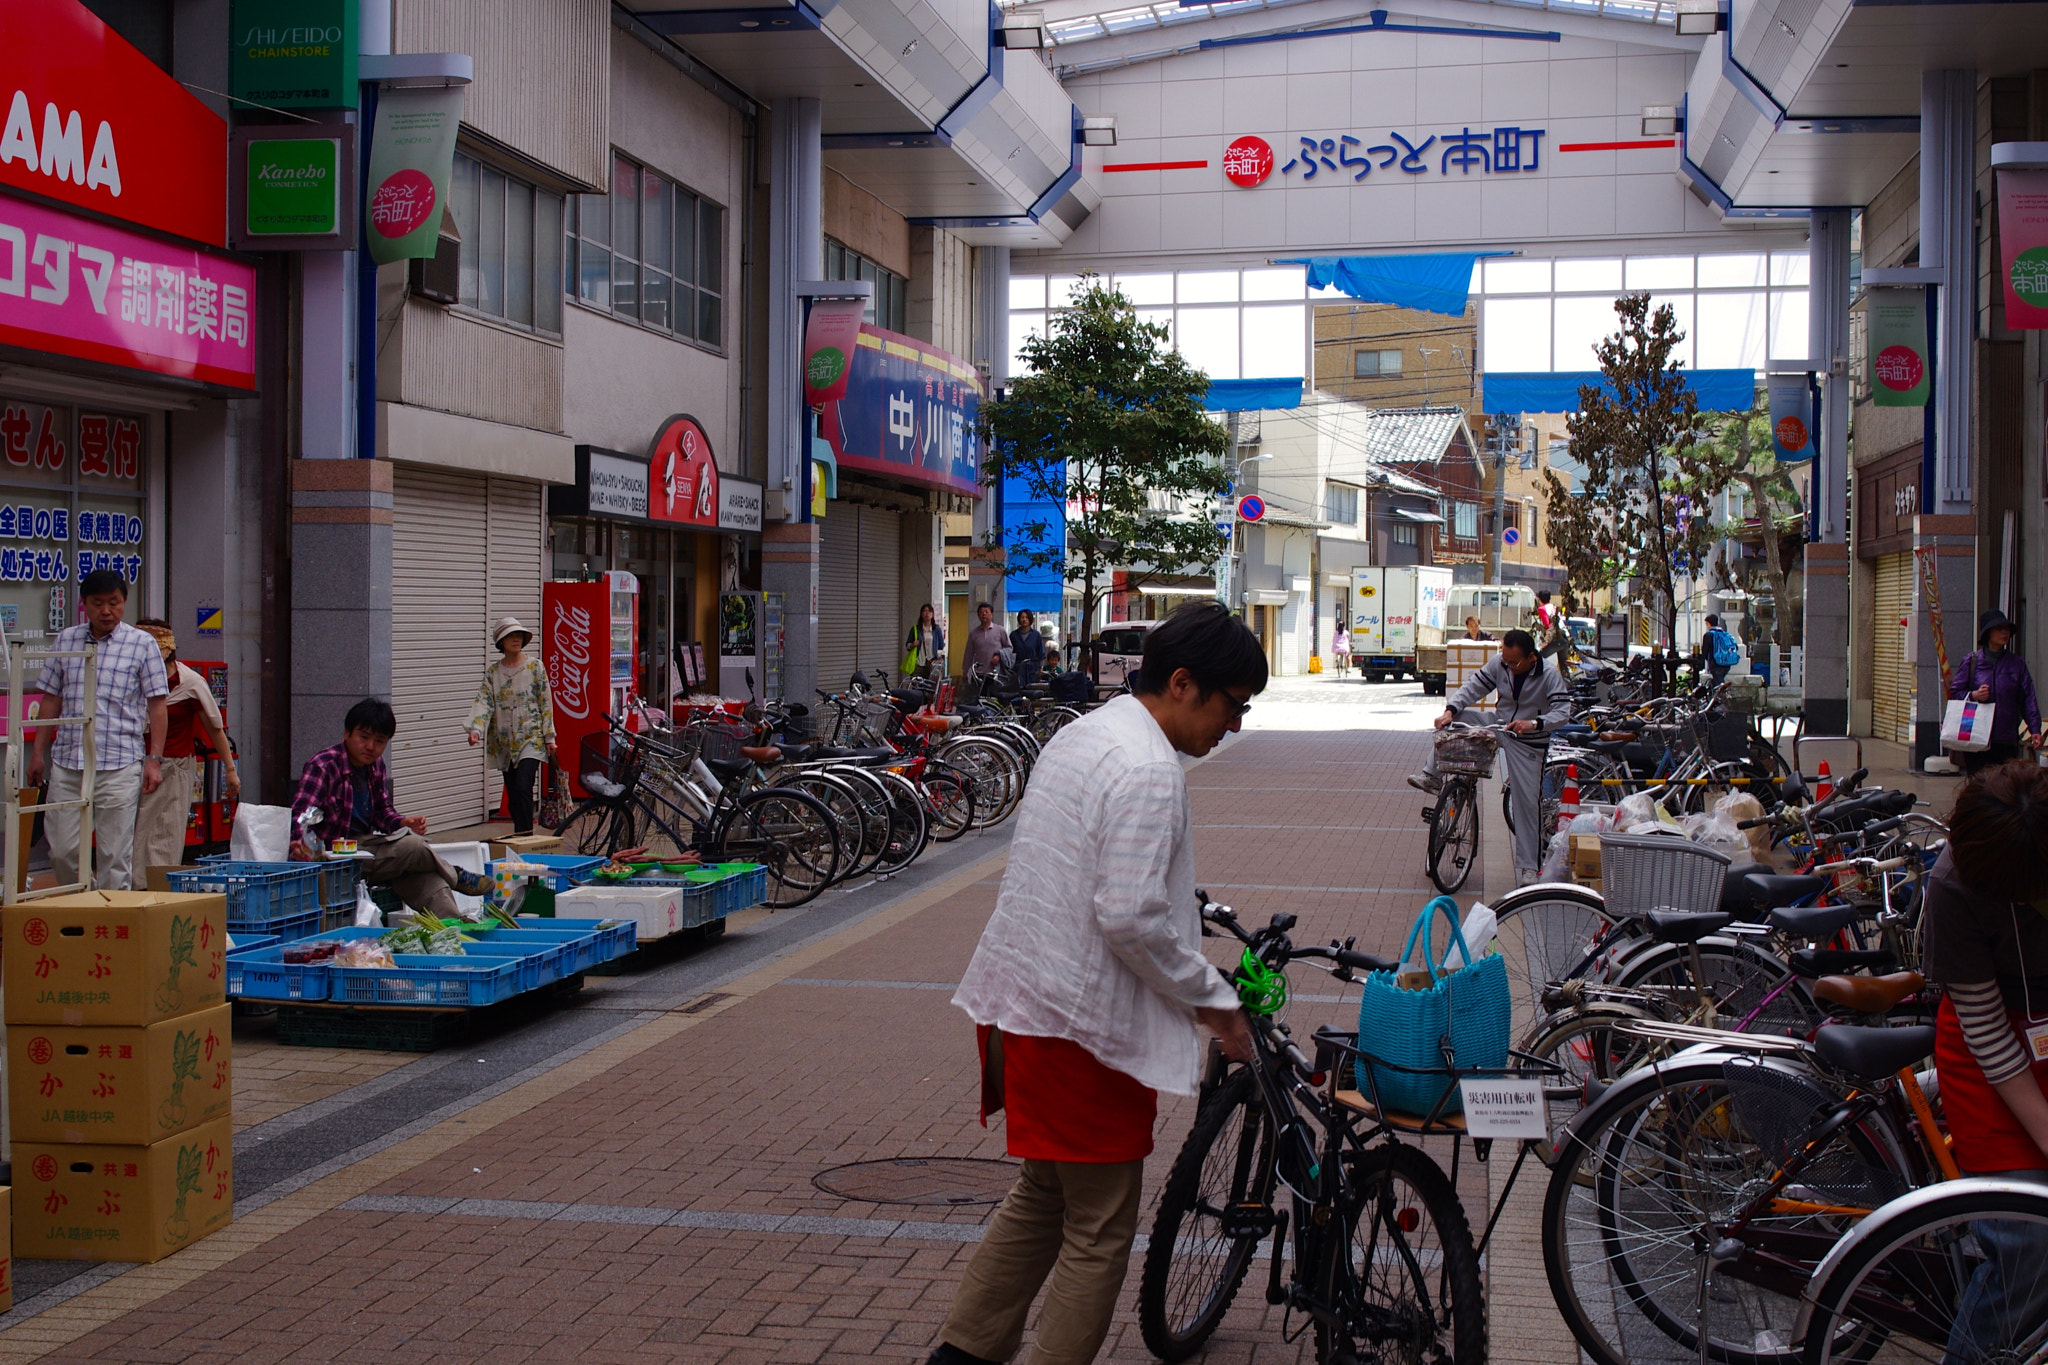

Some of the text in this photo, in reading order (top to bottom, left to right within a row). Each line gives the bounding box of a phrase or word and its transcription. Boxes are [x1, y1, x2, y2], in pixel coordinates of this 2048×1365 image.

[236, 27, 342, 46] SHISEIDO
[248, 46, 330, 58] CHAINSTORE
[0, 90, 122, 198] AMA
[1224, 147, 1260, 159] ぷらっと
[1282, 127, 1545, 180] ぷらっと本町
[258, 163, 327, 179] Kanebo
[1223, 159, 1260, 176] 本町
[373, 184, 419, 202] ぷらっと
[372, 200, 416, 224] 本町
[1875, 365, 1910, 381] 本町
[889, 390, 977, 468] 中川商店
[677, 481, 692, 495] SENYA
[632, 497, 646, 512] BEER
[1355, 616, 1412, 625] クール 宅急便
[95, 925, 130, 940] 共選
[200, 915, 222, 980] かぶ
[35, 953, 112, 979] かぶ
[254, 972, 279, 983] 14170
[36, 990, 110, 1005] JA越後中央
[98, 1044, 133, 1059] 共選
[204, 1027, 227, 1090] かぶ
[39, 1072, 115, 1098] かぶ
[1468, 1091, 1536, 1105] 災害用自転車
[41, 1109, 115, 1123] JA越後中央
[103, 1163, 138, 1178] 共選
[206, 1139, 227, 1200] かぶ
[44, 1189, 121, 1215] かぶ
[46, 1226, 120, 1241] JA越後中央
